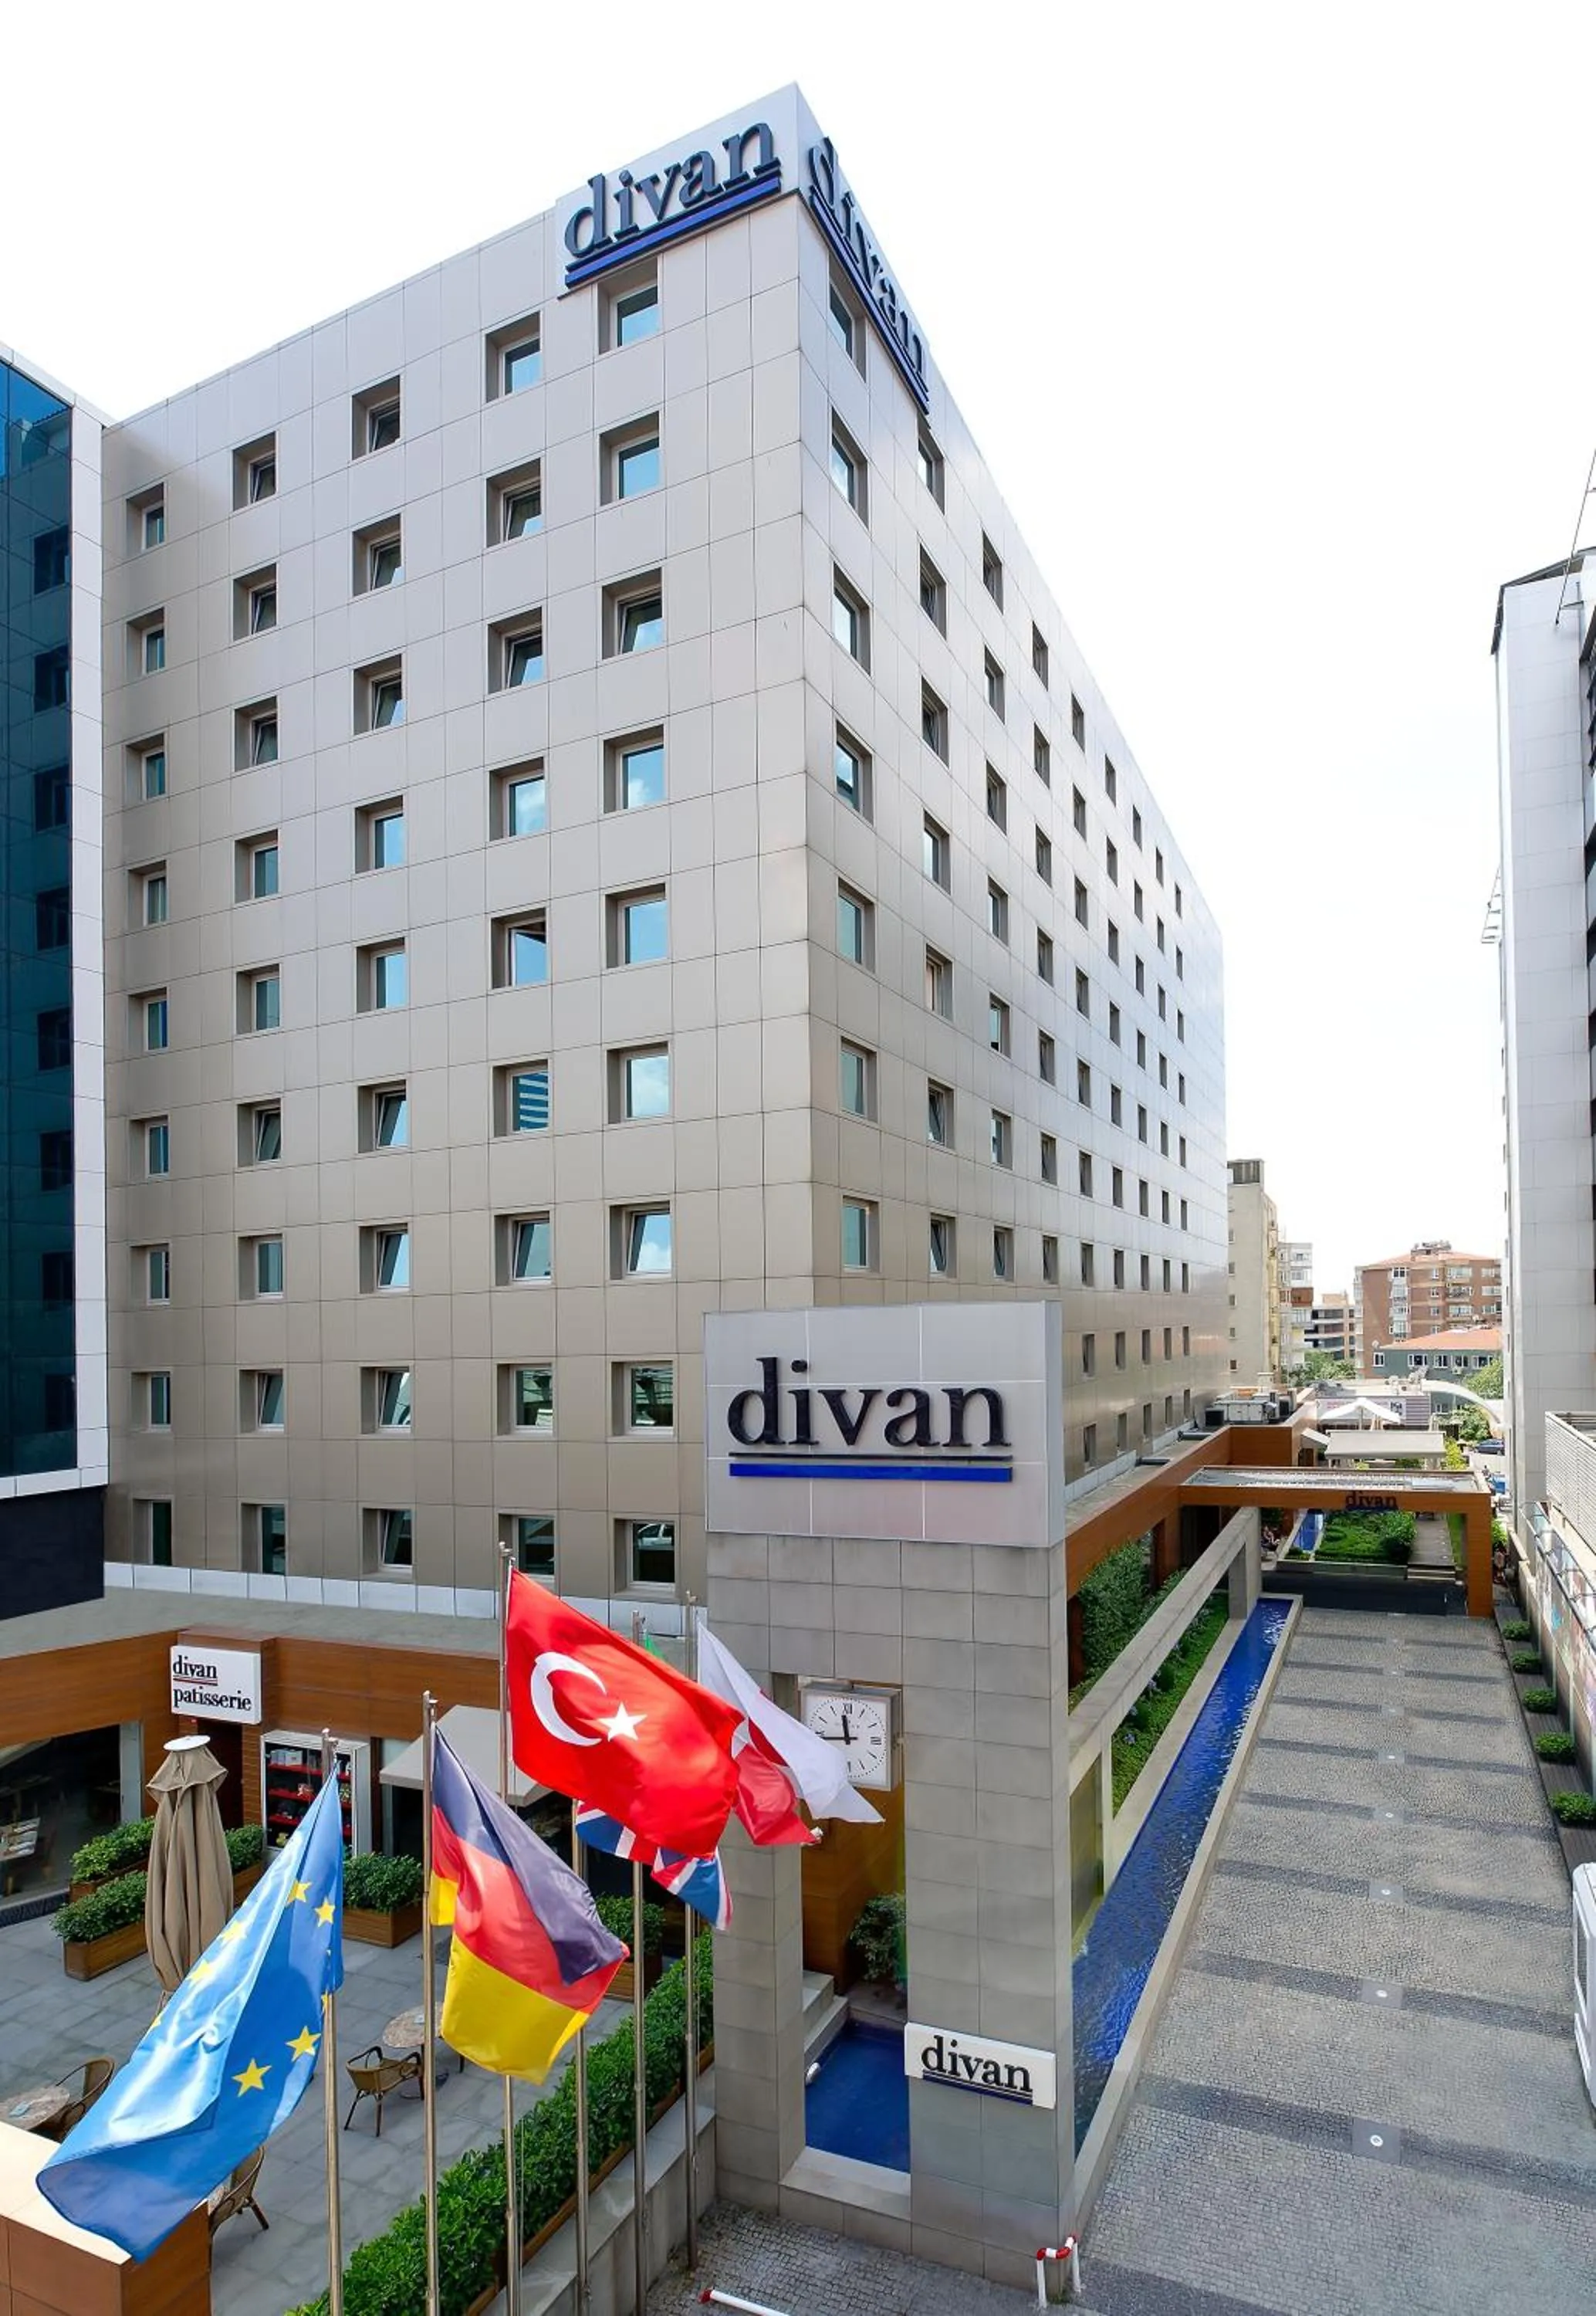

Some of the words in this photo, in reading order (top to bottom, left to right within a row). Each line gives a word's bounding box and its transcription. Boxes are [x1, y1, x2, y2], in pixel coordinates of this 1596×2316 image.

[564, 123, 780, 259] divan
[808, 137, 929, 394] divan
[727, 1356, 1012, 1448] divan
[1345, 1491, 1399, 1508] divan
[173, 1654, 218, 1678] divan
[173, 1685, 252, 1712] patisserie
[921, 2034, 1033, 2092] divan
